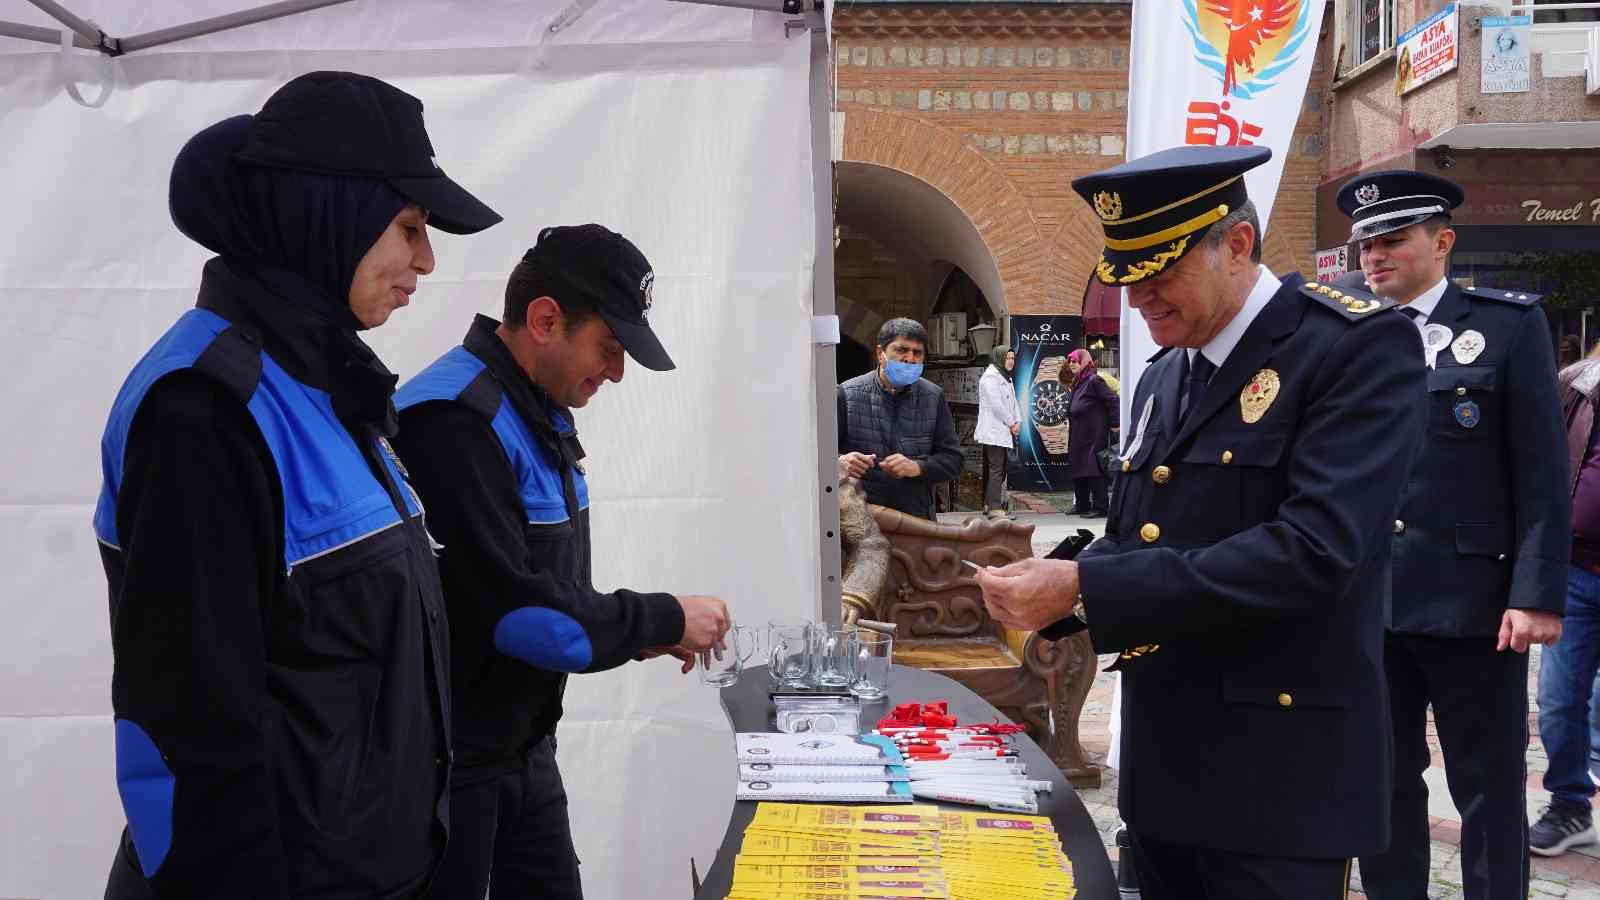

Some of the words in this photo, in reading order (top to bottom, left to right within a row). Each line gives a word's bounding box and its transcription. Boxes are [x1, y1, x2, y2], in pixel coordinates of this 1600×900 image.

[1420, 20, 1447, 46] ASYA
[1521, 200, 1583, 222] Temel
[1021, 333, 1070, 341] NACAR
